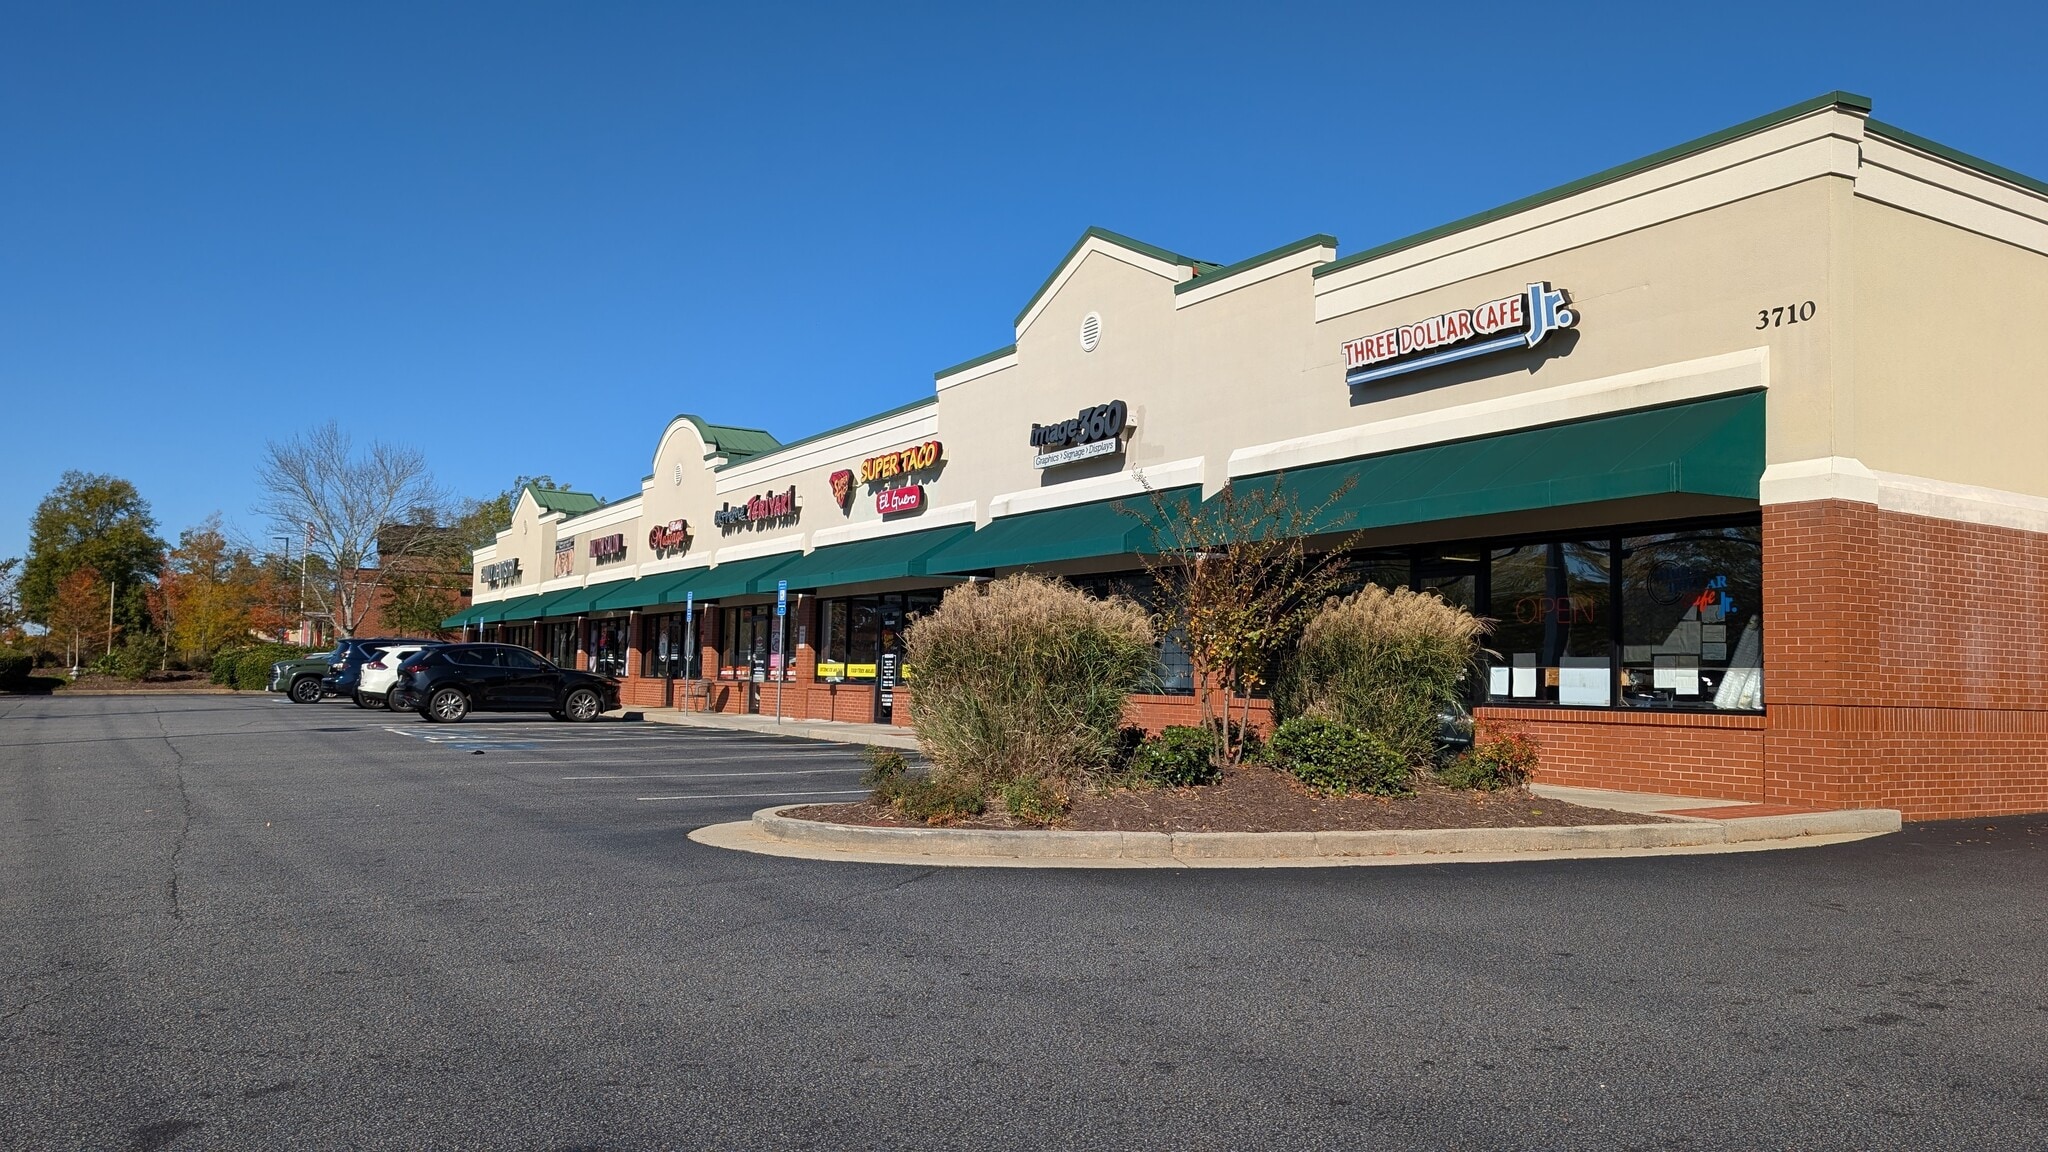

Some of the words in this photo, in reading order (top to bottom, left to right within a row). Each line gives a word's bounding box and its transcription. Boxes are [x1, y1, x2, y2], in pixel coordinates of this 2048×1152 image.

[1344, 333, 1397, 366] THREE
[1400, 312, 1471, 352] DOLLAR
[1475, 299, 1521, 330] CAFE
[1528, 284, 1573, 346] Jr.
[1756, 301, 1816, 330] 3710
[1030, 400, 1123, 446] image360
[861, 453, 899, 482] SUPER
[901, 442, 937, 473] TACO
[1035, 453, 1060, 467] Graphics
[1063, 448, 1086, 461] Signage
[1089, 441, 1114, 454] Displays
[879, 493, 890, 510] El
[1516, 597, 1594, 624] OPEN
[1717, 592, 1738, 619] Jr.
